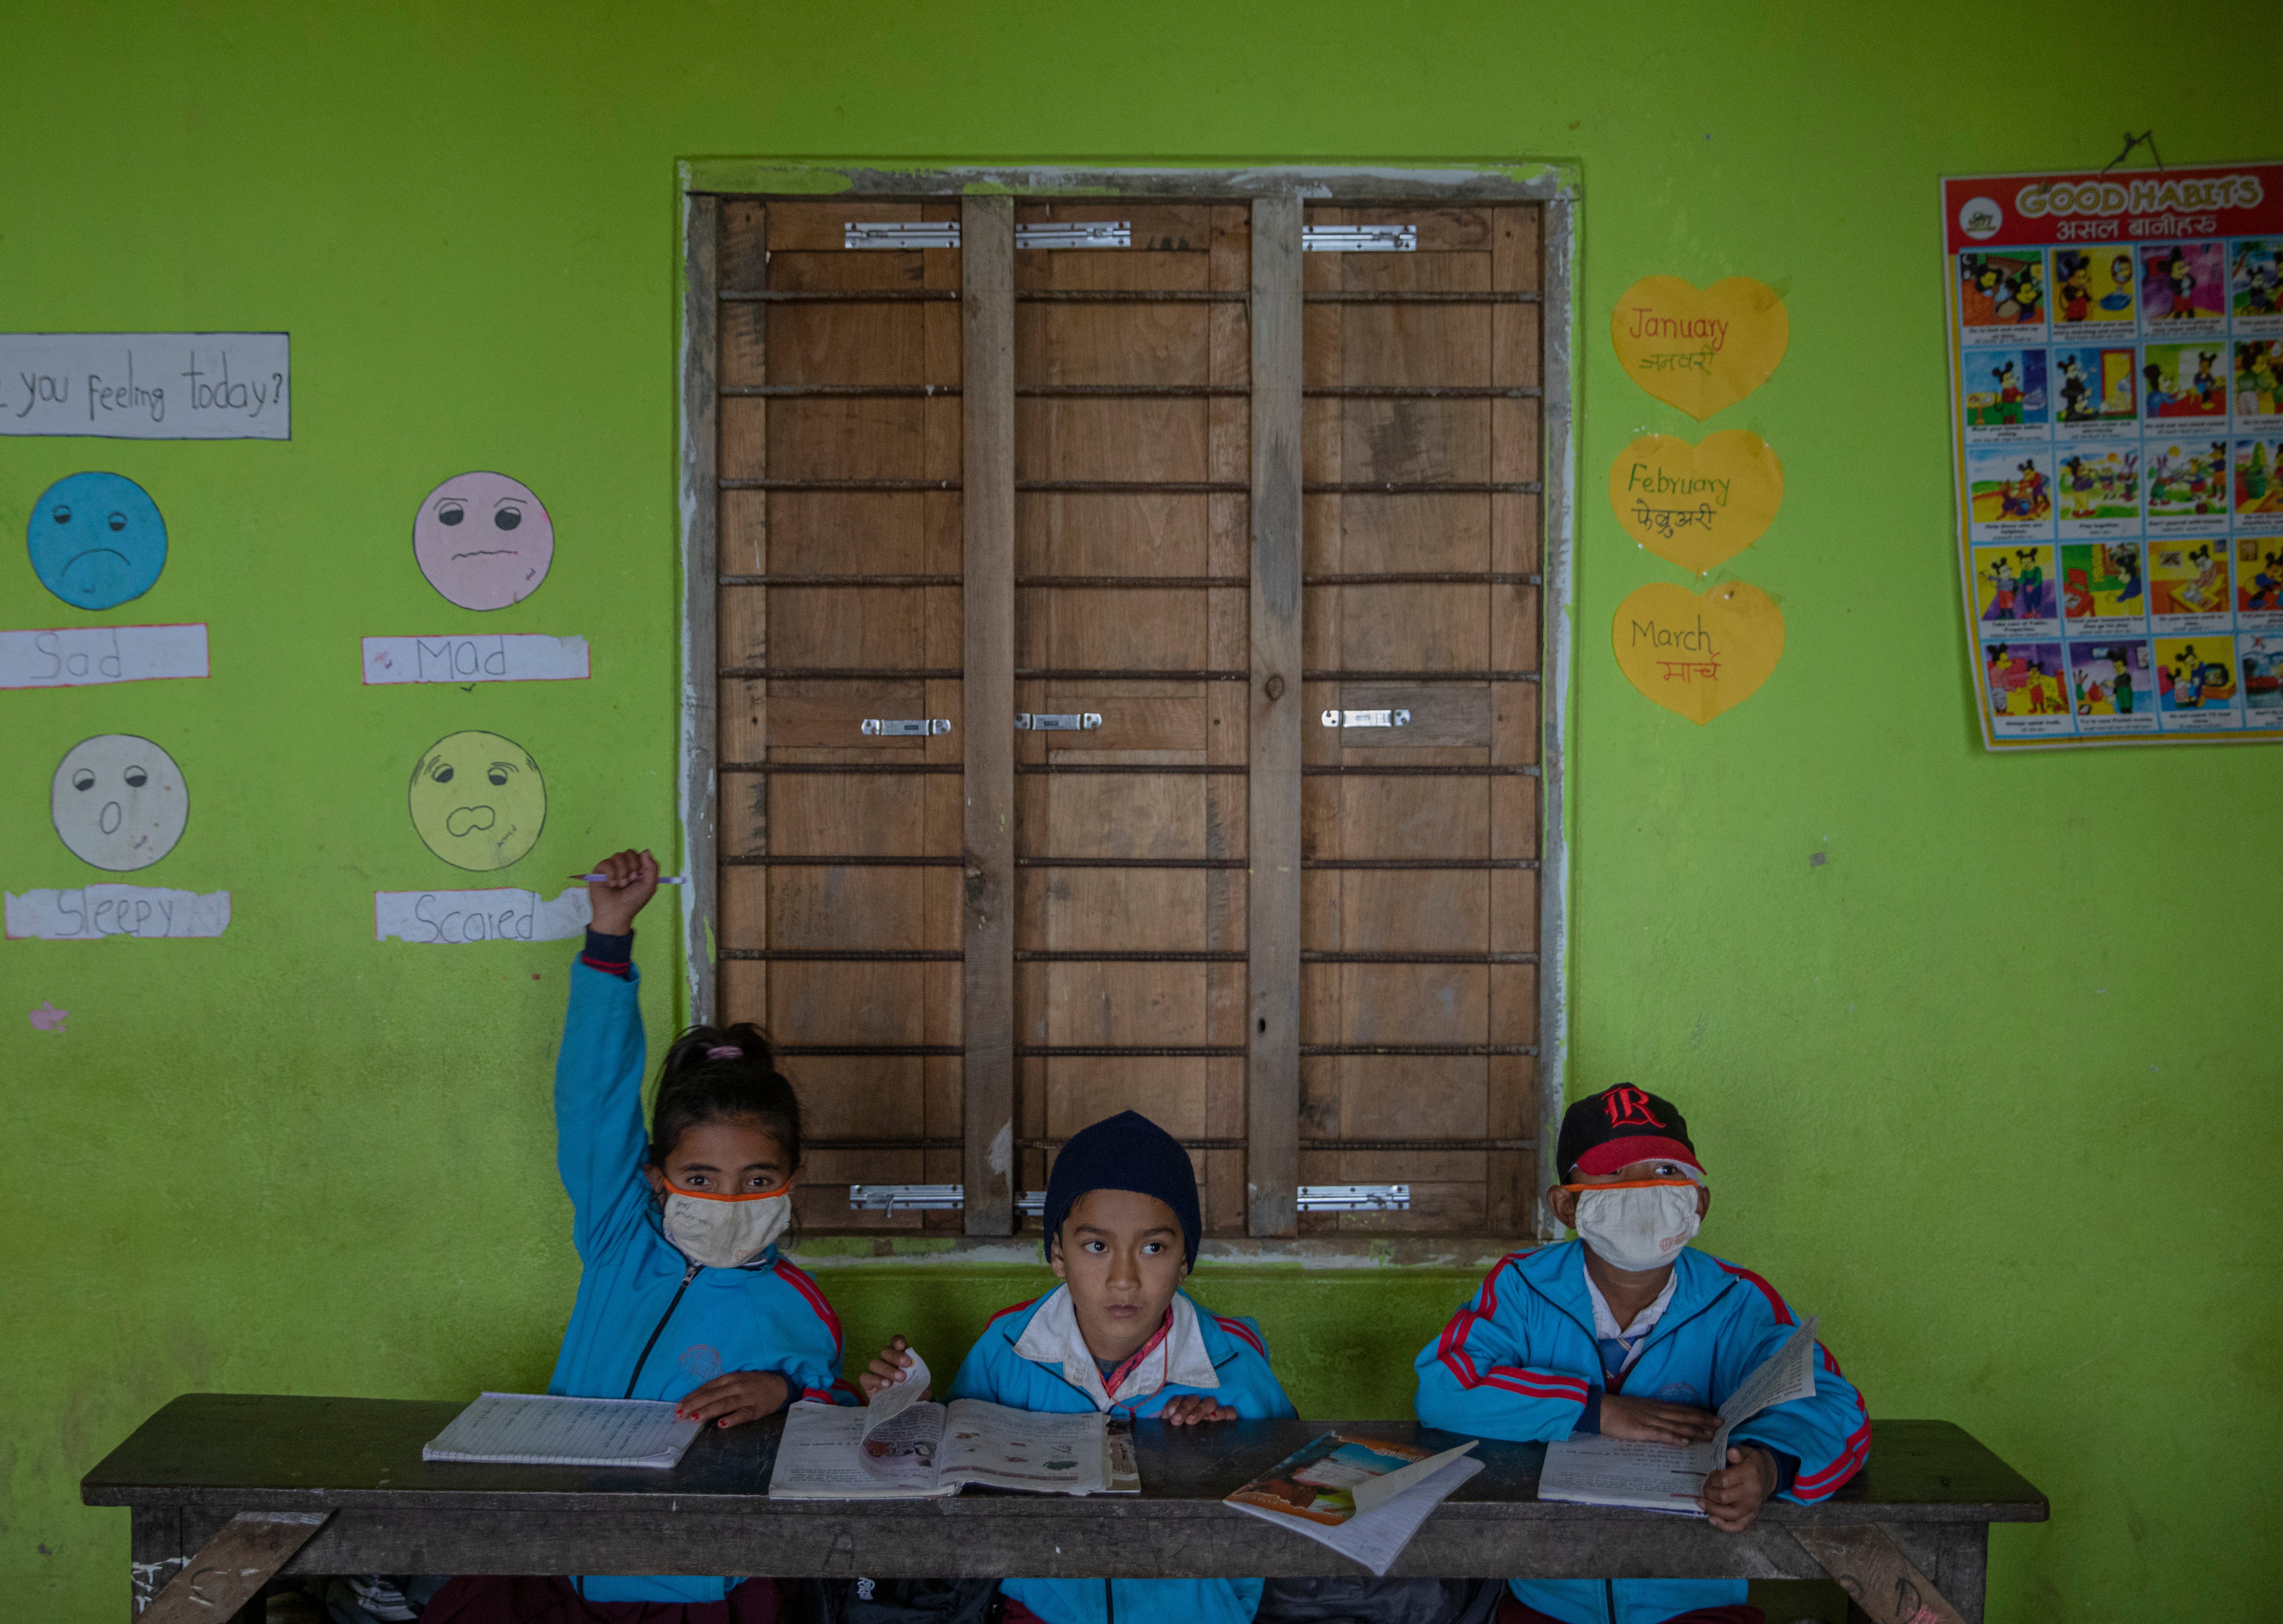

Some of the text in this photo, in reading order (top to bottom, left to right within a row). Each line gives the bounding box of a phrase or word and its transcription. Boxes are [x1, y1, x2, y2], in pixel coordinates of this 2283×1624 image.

[2017, 176, 2262, 217] GOOD HABITS
[2056, 219, 2118, 241] असल
[1629, 308, 1729, 351] January
[16, 371, 68, 417] you
[181, 351, 283, 417] today?
[1628, 463, 1730, 506] February
[30, 629, 122, 680] Sad
[1631, 614, 1713, 654] March
[416, 636, 506, 679] Mad
[1656, 652, 1721, 683] मार्च
[55, 889, 173, 937] Sleepy
[415, 892, 536, 944] Scared
